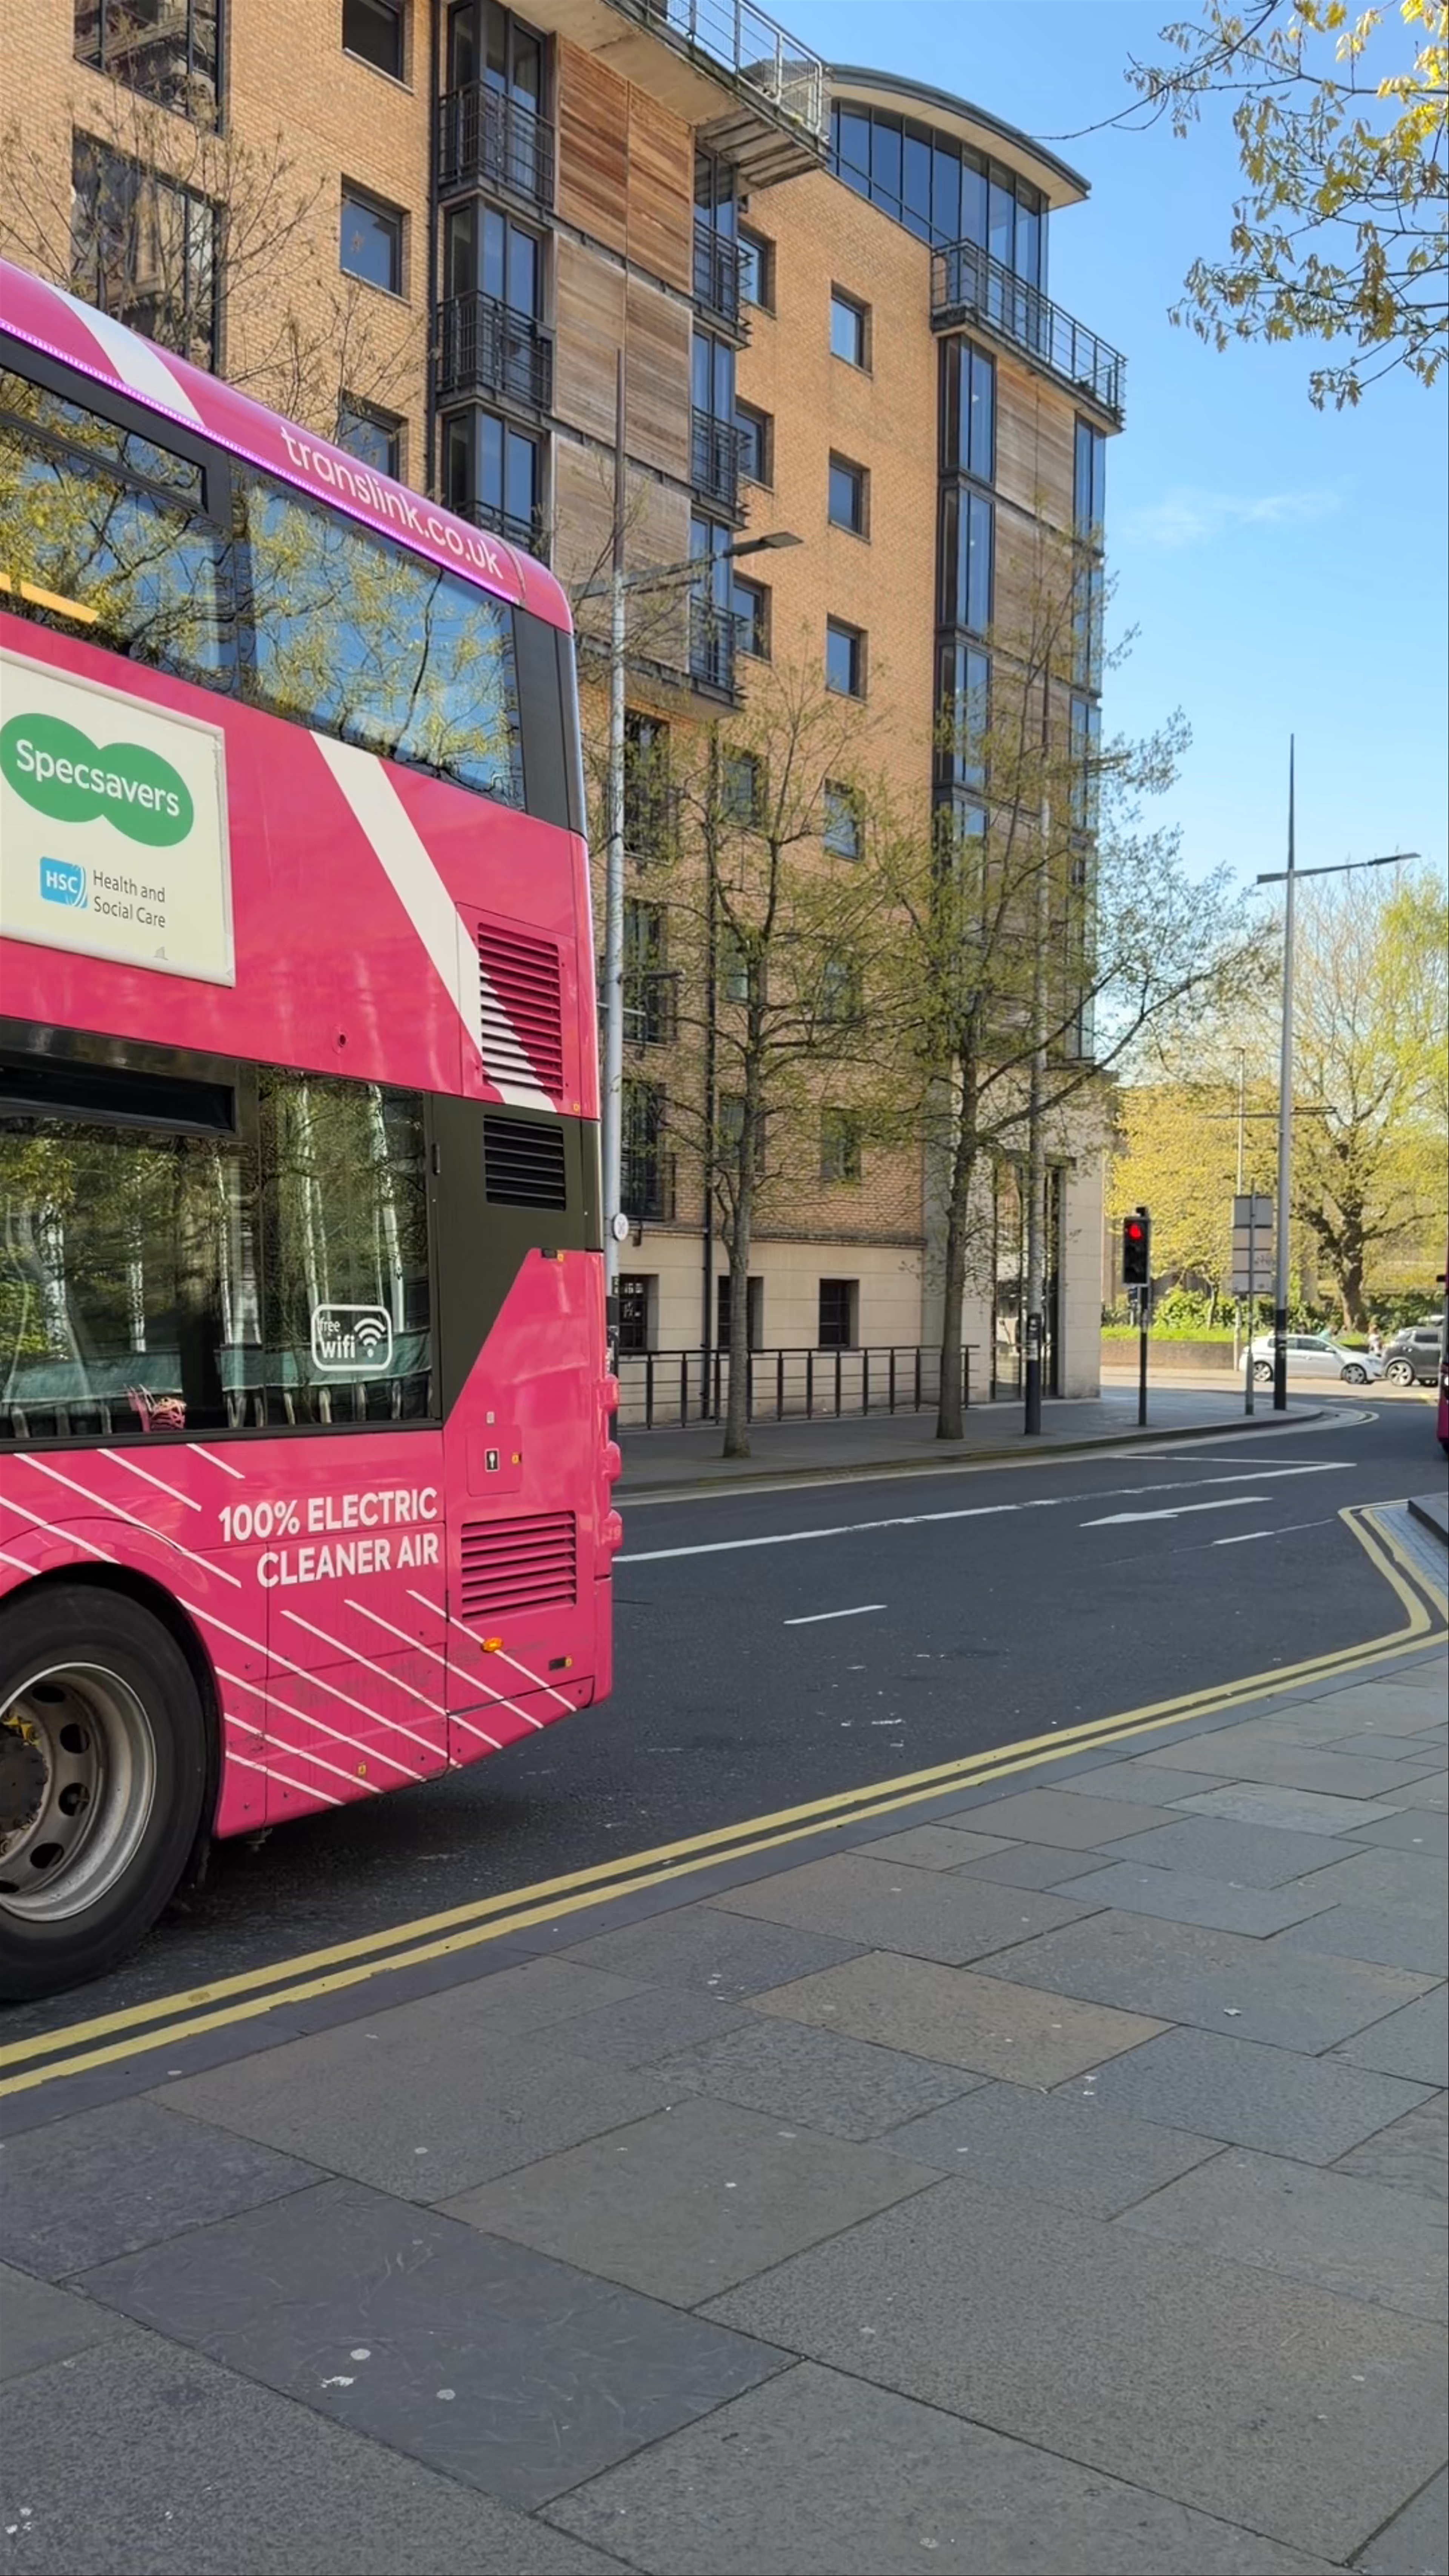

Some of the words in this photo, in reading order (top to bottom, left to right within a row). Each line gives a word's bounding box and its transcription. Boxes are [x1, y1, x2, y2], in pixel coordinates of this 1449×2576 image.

[281, 425, 504, 579] translink.co.uk
[16, 739, 180, 817] Specsavers
[46, 870, 78, 894] HSC
[93, 869, 137, 896] Health
[141, 887, 166, 903] and
[94, 896, 133, 920] Social
[137, 907, 166, 928] Care
[320, 1317, 341, 1332] free
[321, 1334, 355, 1358] wifi
[218, 1499, 300, 1542] 100%
[308, 1487, 437, 1532] ELECTRIC
[257, 1538, 391, 1588] CLEANER
[396, 1532, 439, 1569] AIR
